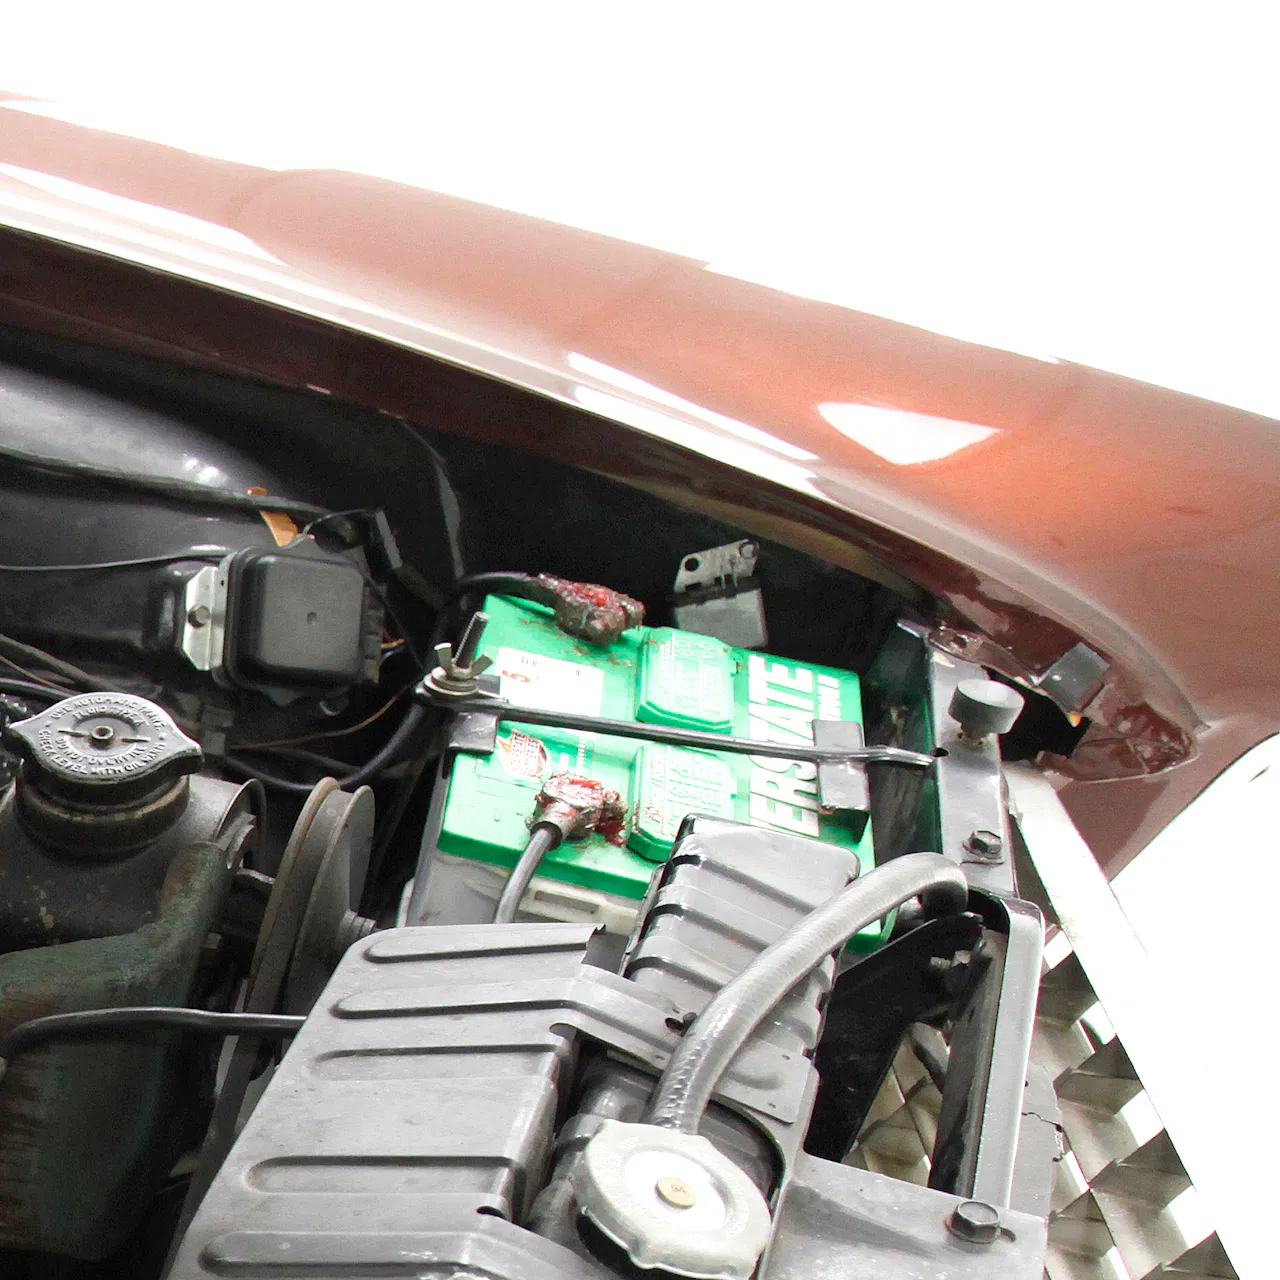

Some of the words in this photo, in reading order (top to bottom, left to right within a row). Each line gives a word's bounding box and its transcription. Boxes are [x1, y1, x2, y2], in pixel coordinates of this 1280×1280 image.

[50, 704, 73, 719] USE
[75, 697, 140, 709] AUTOMATIC
[73, 704, 107, 720] FLUID
[39, 729, 57, 758] CHECK
[51, 755, 89, 775] LEVEL
[90, 766, 125, 776] WITH
[124, 760, 147, 772] OIL
[748, 654, 821, 838] ERSTATE
